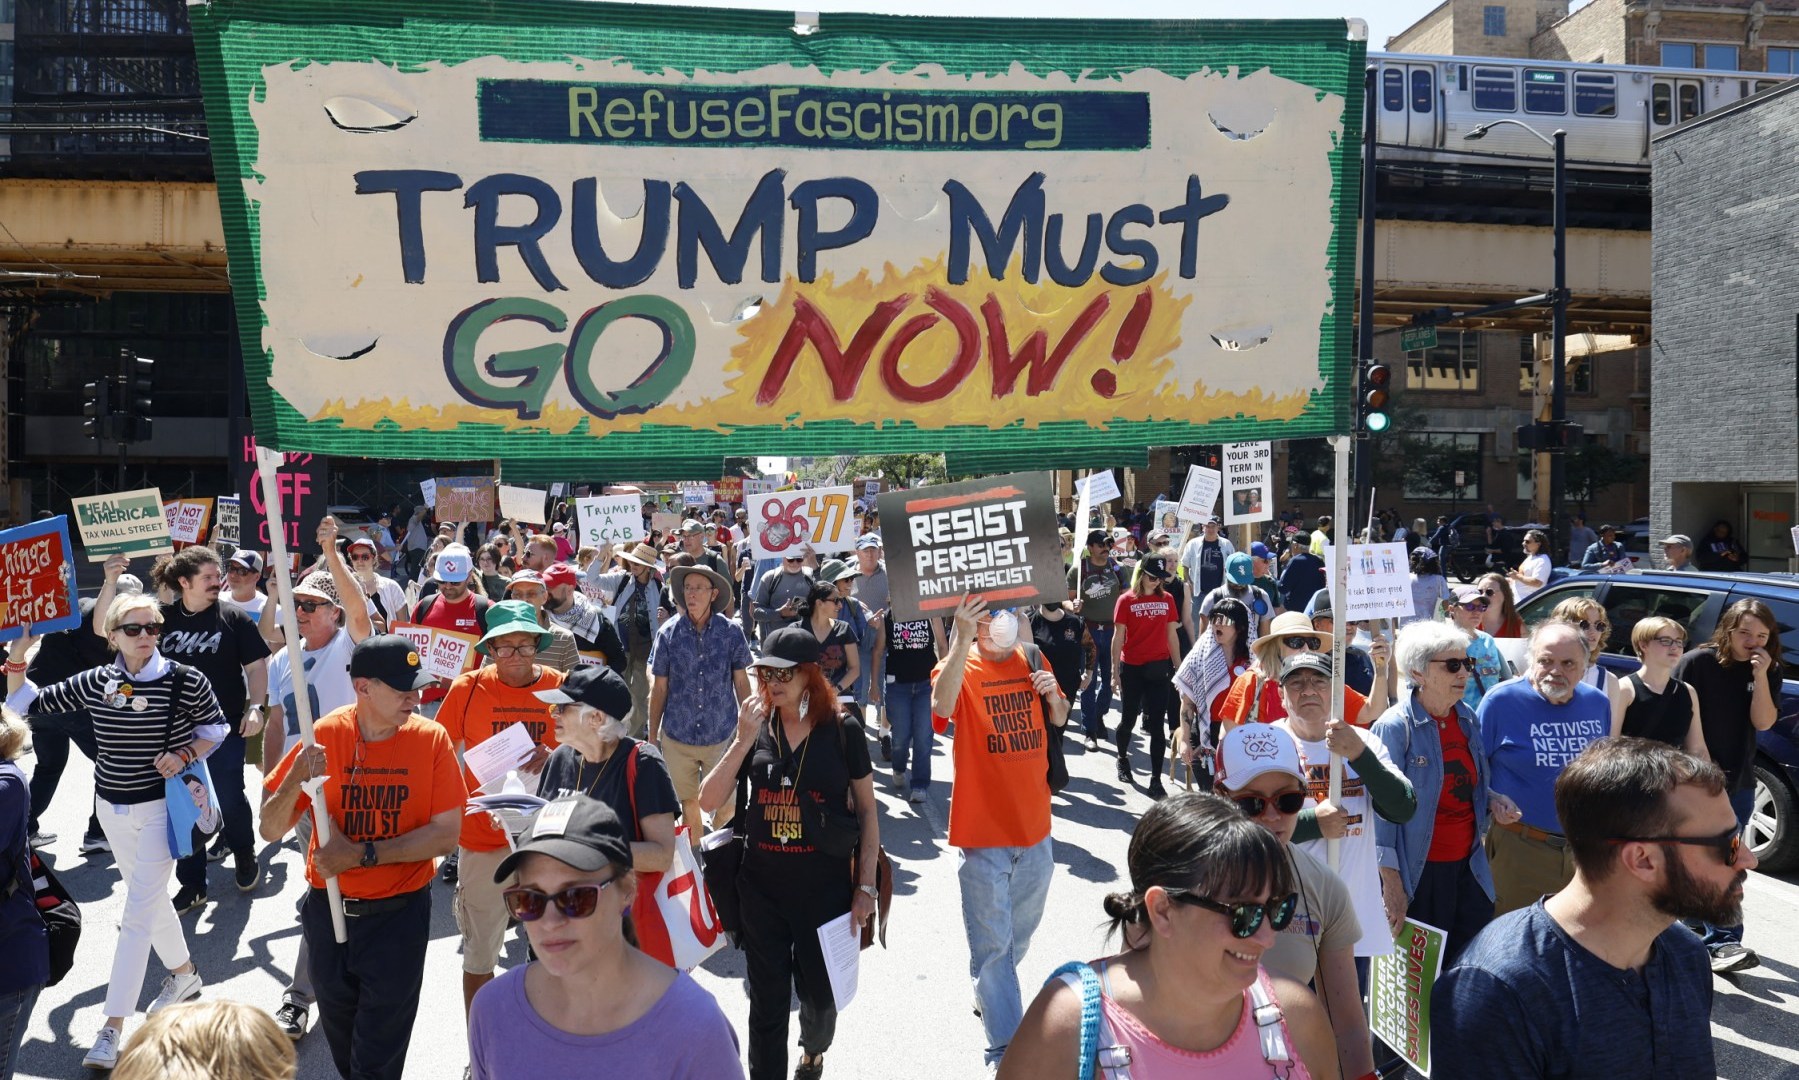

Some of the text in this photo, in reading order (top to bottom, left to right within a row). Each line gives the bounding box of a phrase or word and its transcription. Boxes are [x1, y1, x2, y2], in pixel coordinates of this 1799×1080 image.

[567, 86, 1063, 150] RefuseFascism.org
[355, 169, 881, 292] TRUMP
[443, 284, 1153, 420] GO NOW!
[1226, 449, 1270, 461] YOUR 3RD
[1229, 462, 1264, 473] TERM IN
[1231, 474, 1264, 486] PRISON!
[85, 499, 119, 516] HEAL
[89, 507, 151, 525] AMERICA
[181, 506, 202, 517] NOT
[437, 503, 490, 521] CLASS
[583, 504, 637, 518] TRUMP'S
[178, 516, 199, 527] BILLION-
[178, 525, 194, 533] AIRES
[605, 516, 613, 526] A
[908, 500, 1027, 547] RESIST
[84, 522, 163, 540] TAX WALL STREET
[218, 523, 240, 539] POWER
[258, 520, 300, 547] CI
[590, 526, 633, 542] SCAB
[915, 536, 1030, 577] PERSIST
[3, 574, 34, 602] La
[918, 565, 1034, 596] ANTI-FASCIST
[1367, 586, 1376, 595] DEI
[1130, 602, 1169, 612] SOLIDARITY
[893, 620, 929, 631] ANGRY
[161, 630, 222, 654] CWA
[893, 629, 929, 640] WOMEN
[437, 638, 466, 654] NOT
[432, 648, 463, 663] BILLION-
[434, 657, 456, 669] AIRES
[983, 690, 1034, 715] TRUMP
[992, 710, 1034, 734] MUST
[1529, 719, 1603, 738] ACTIVISTS
[492, 720, 547, 743] TMP
[987, 728, 1042, 754] GO NOW!
[1532, 737, 1589, 752] NEVER
[1535, 752, 1584, 768] RETI
[341, 784, 409, 810] TRUMP
[763, 805, 801, 823] NOTHI
[344, 810, 401, 836] MUST
[771, 822, 803, 839] LESS!
[758, 842, 816, 853] revcom.u
[1396, 944, 1408, 1055] RESEARCH
[1408, 926, 1430, 1063] SAVES LIVES!
